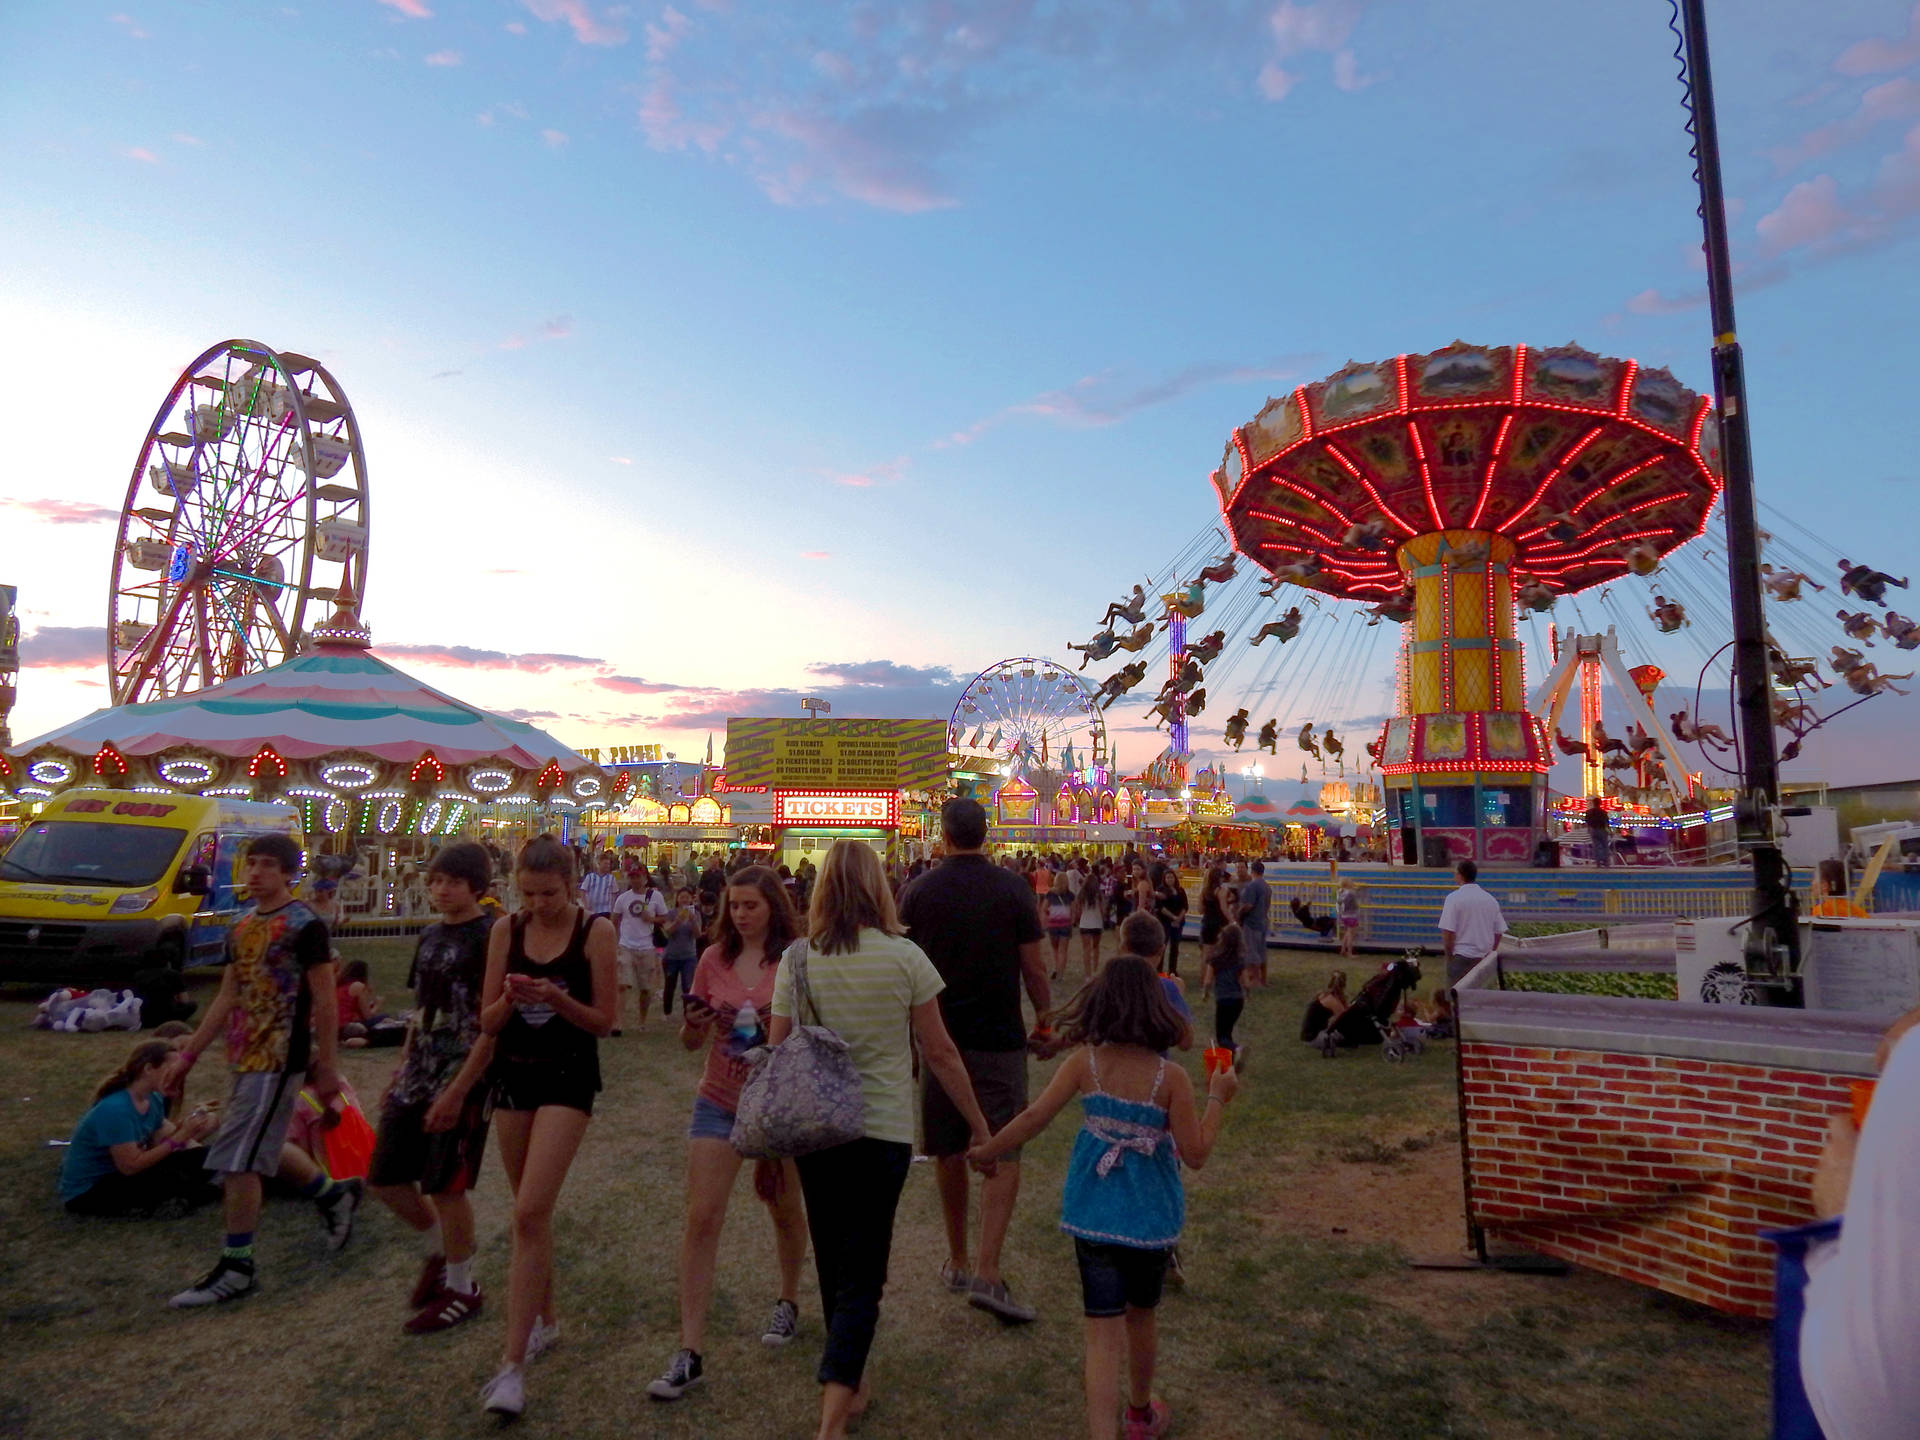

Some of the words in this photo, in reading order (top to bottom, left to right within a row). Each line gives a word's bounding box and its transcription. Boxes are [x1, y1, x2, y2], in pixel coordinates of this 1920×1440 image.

[782, 719, 892, 737] TICKETS
[610, 743, 662, 764] PRIZES
[788, 801, 883, 816] TICKETS
